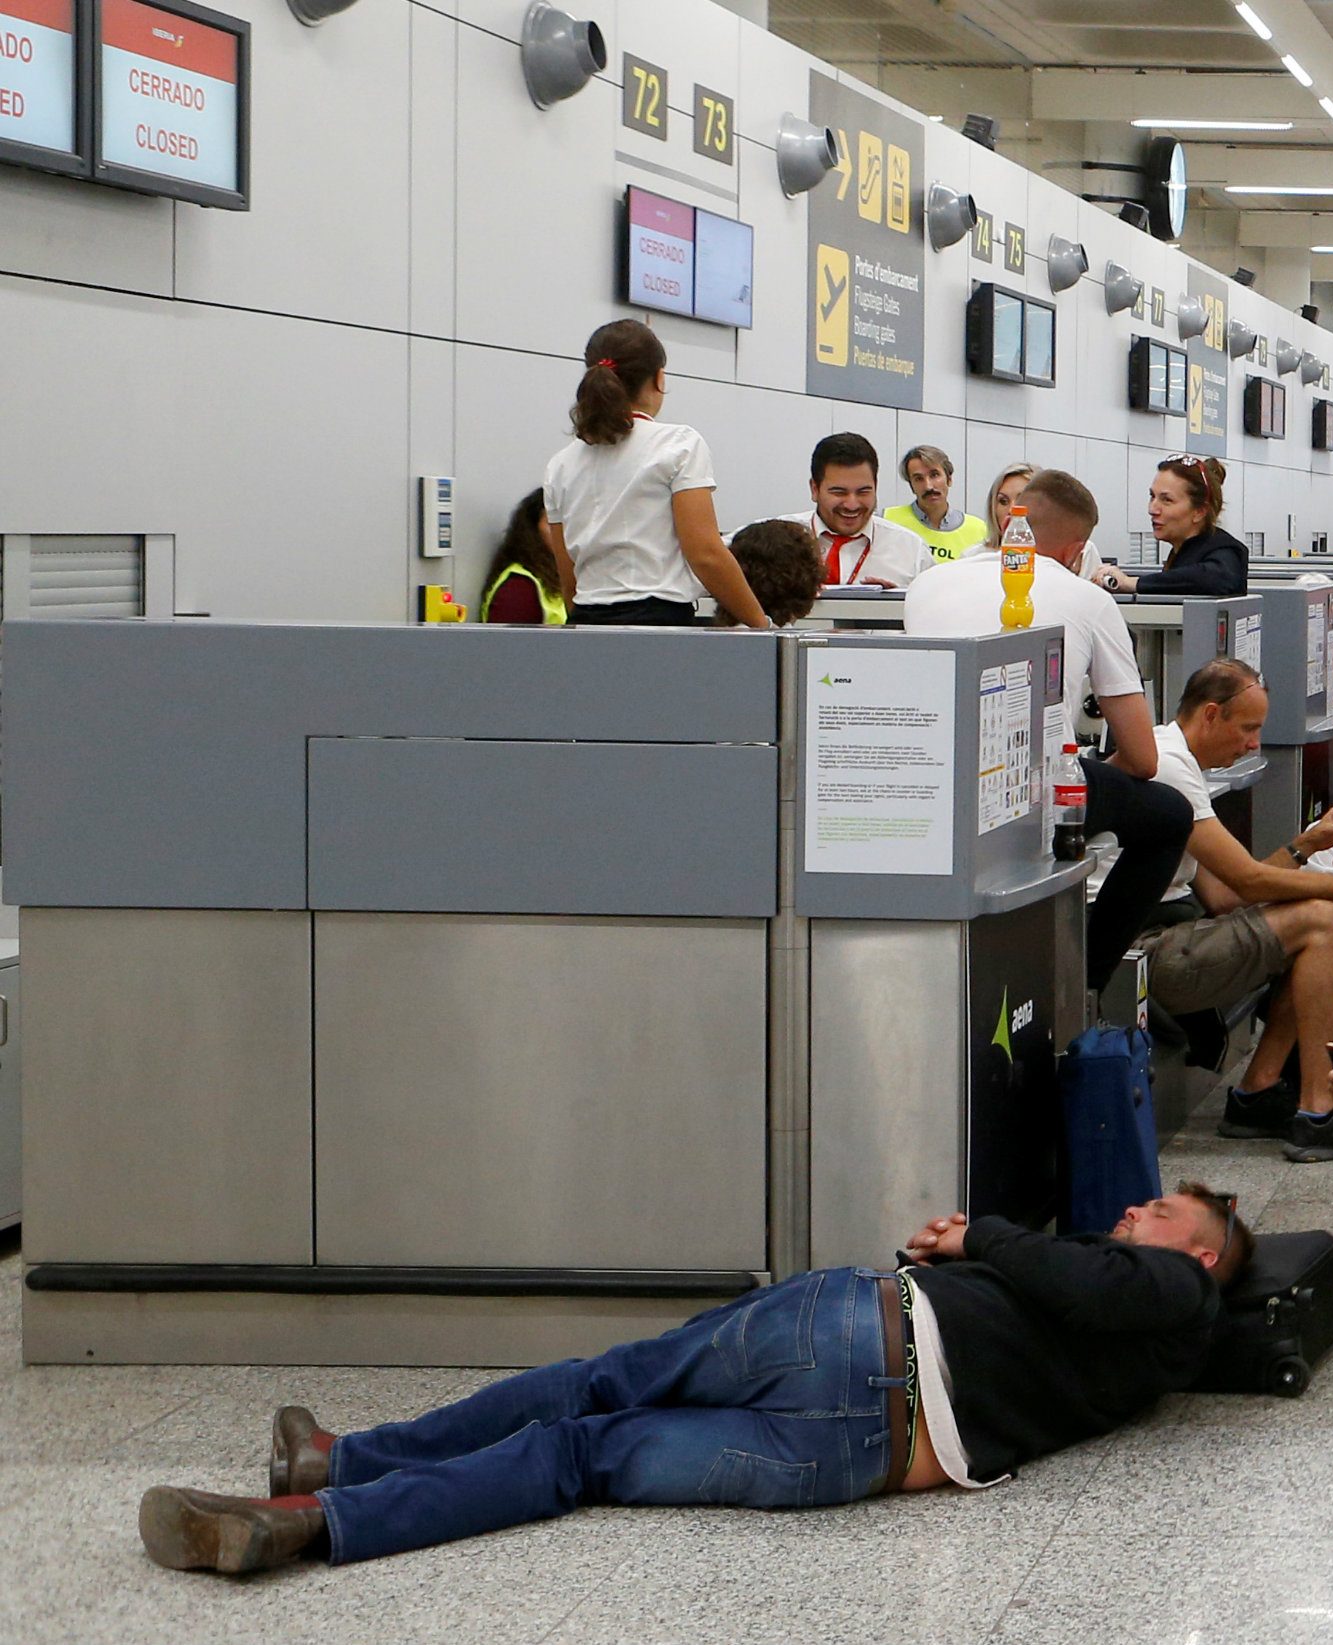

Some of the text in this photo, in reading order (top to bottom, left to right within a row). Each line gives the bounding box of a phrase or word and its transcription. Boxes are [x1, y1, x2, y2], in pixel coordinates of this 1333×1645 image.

[129, 68, 205, 111] CERRADO
[633, 66, 661, 127] 72
[136, 124, 198, 160] CLOSED
[702, 96, 727, 152] 73
[639, 237, 685, 264] CERRADO
[977, 216, 990, 255] 74
[1009, 229, 1022, 267] 75
[643, 272, 681, 297] CLOSED
[1154, 292, 1164, 322] 77
[1004, 553, 1029, 566] FANTA
[1012, 999, 1033, 1034] aena
